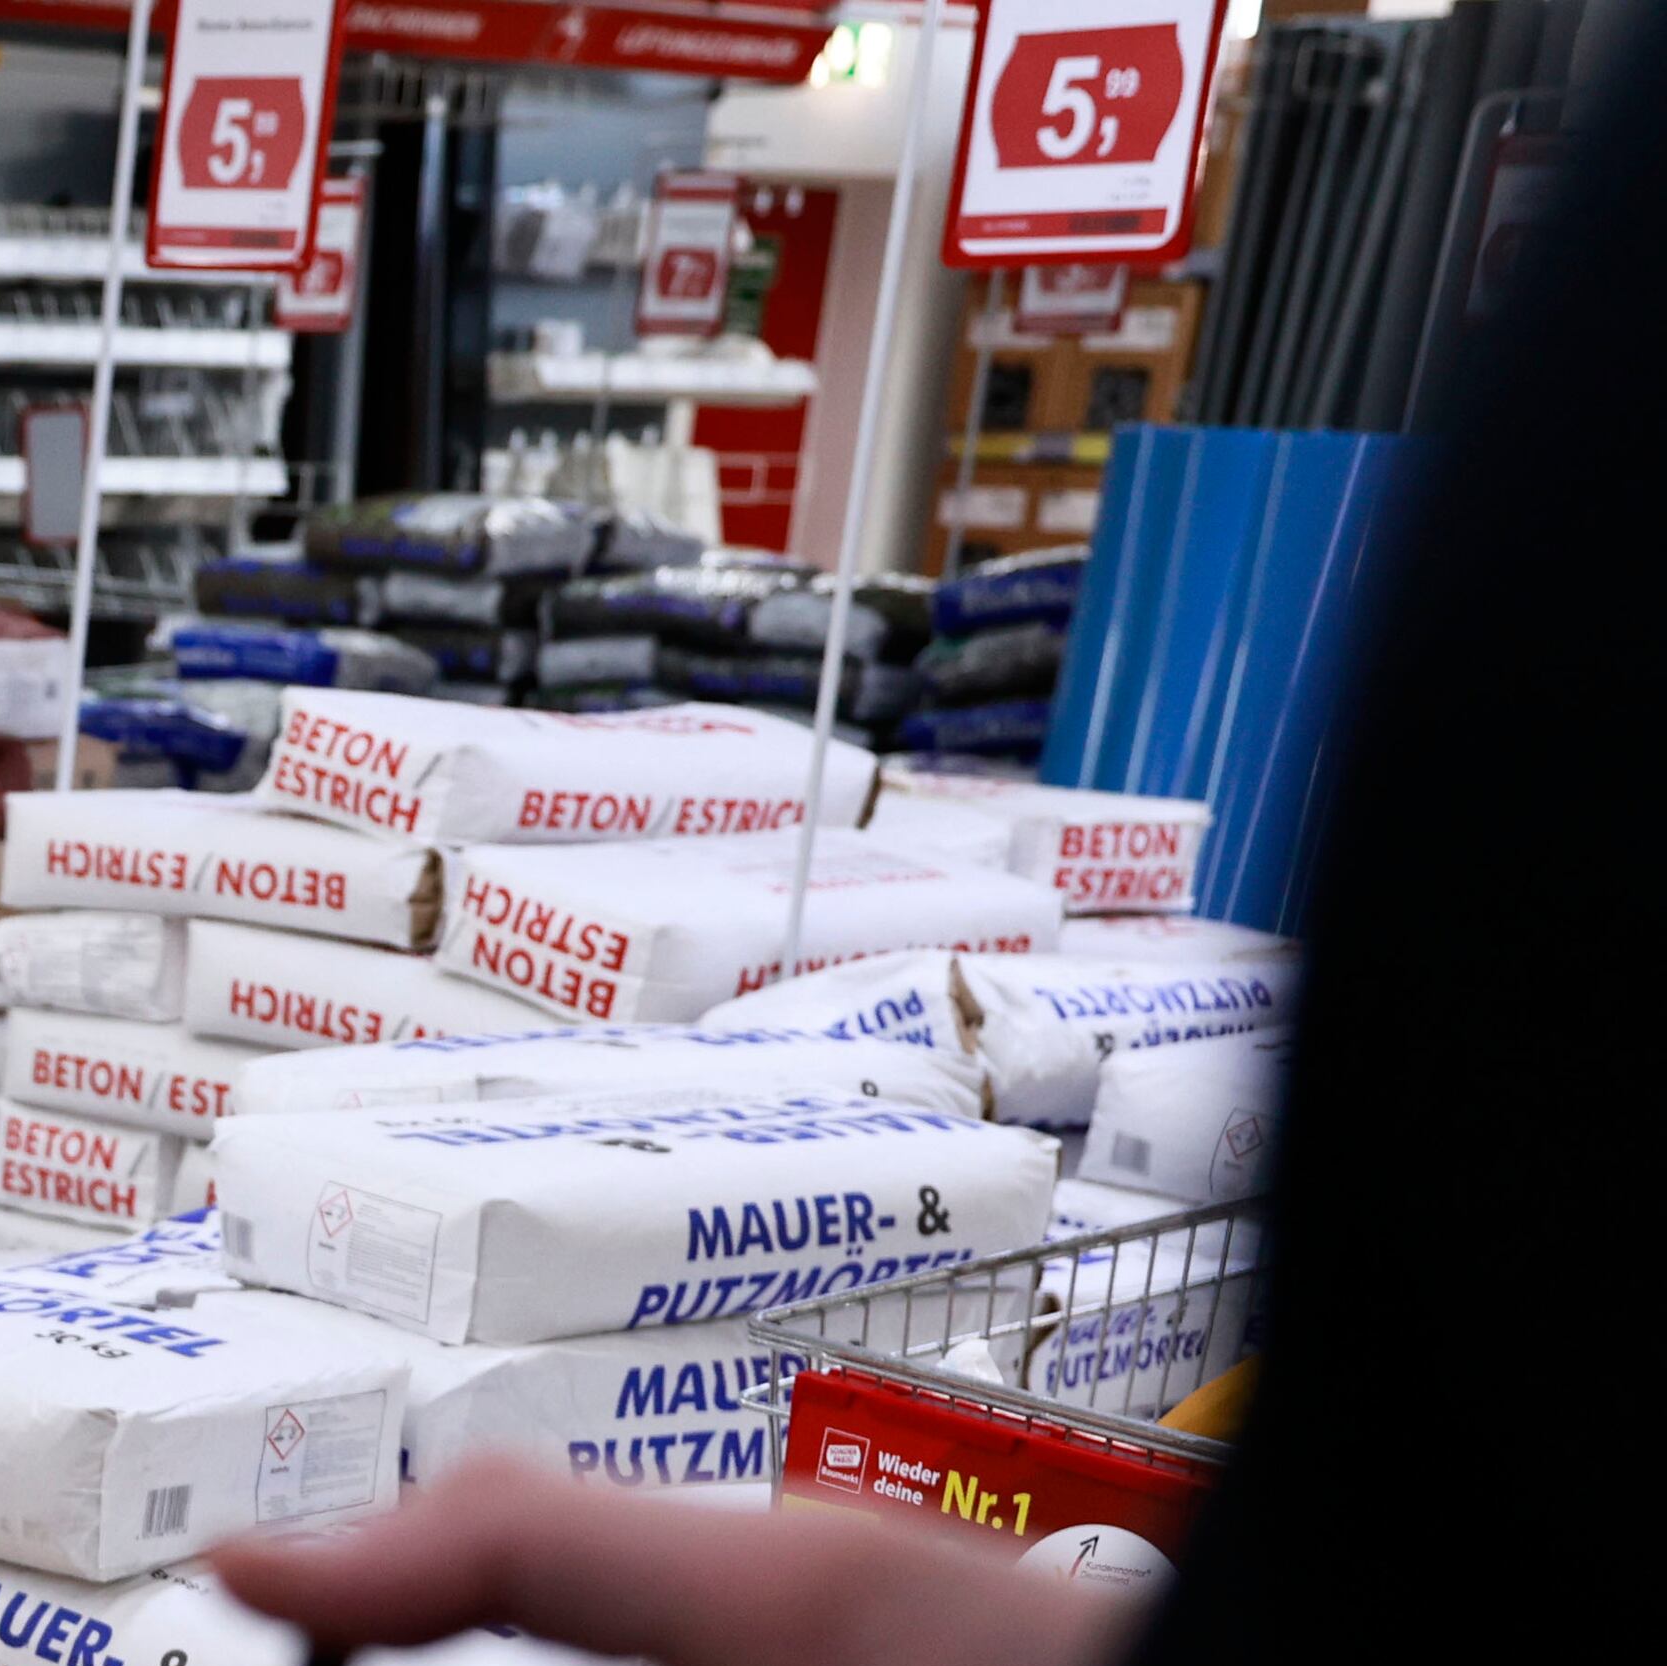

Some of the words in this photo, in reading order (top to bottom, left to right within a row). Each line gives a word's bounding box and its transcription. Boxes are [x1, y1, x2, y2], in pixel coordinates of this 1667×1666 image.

[1034, 54, 1142, 160] 5,99
[286, 709, 410, 779] BETON
[272, 754, 423, 834] ESTRICH
[518, 788, 652, 833] BETON
[46, 838, 189, 892] ESTRICH
[1059, 823, 1179, 860] BETON
[216, 859, 348, 911] BETON
[1053, 865, 1182, 902] ESTRICH
[463, 872, 630, 973] ESTRICH
[472, 931, 618, 1020] BETON
[229, 978, 384, 1044] ESTRICH
[30, 1048, 143, 1102] BETON
[4, 1116, 119, 1172] BETON
[1, 1159, 137, 1219] ESTRICH
[686, 1190, 897, 1264] MAUER-
[915, 1183, 952, 1239] &
[873, 1474, 924, 1506] deine
[878, 1449, 941, 1487] Wieder
